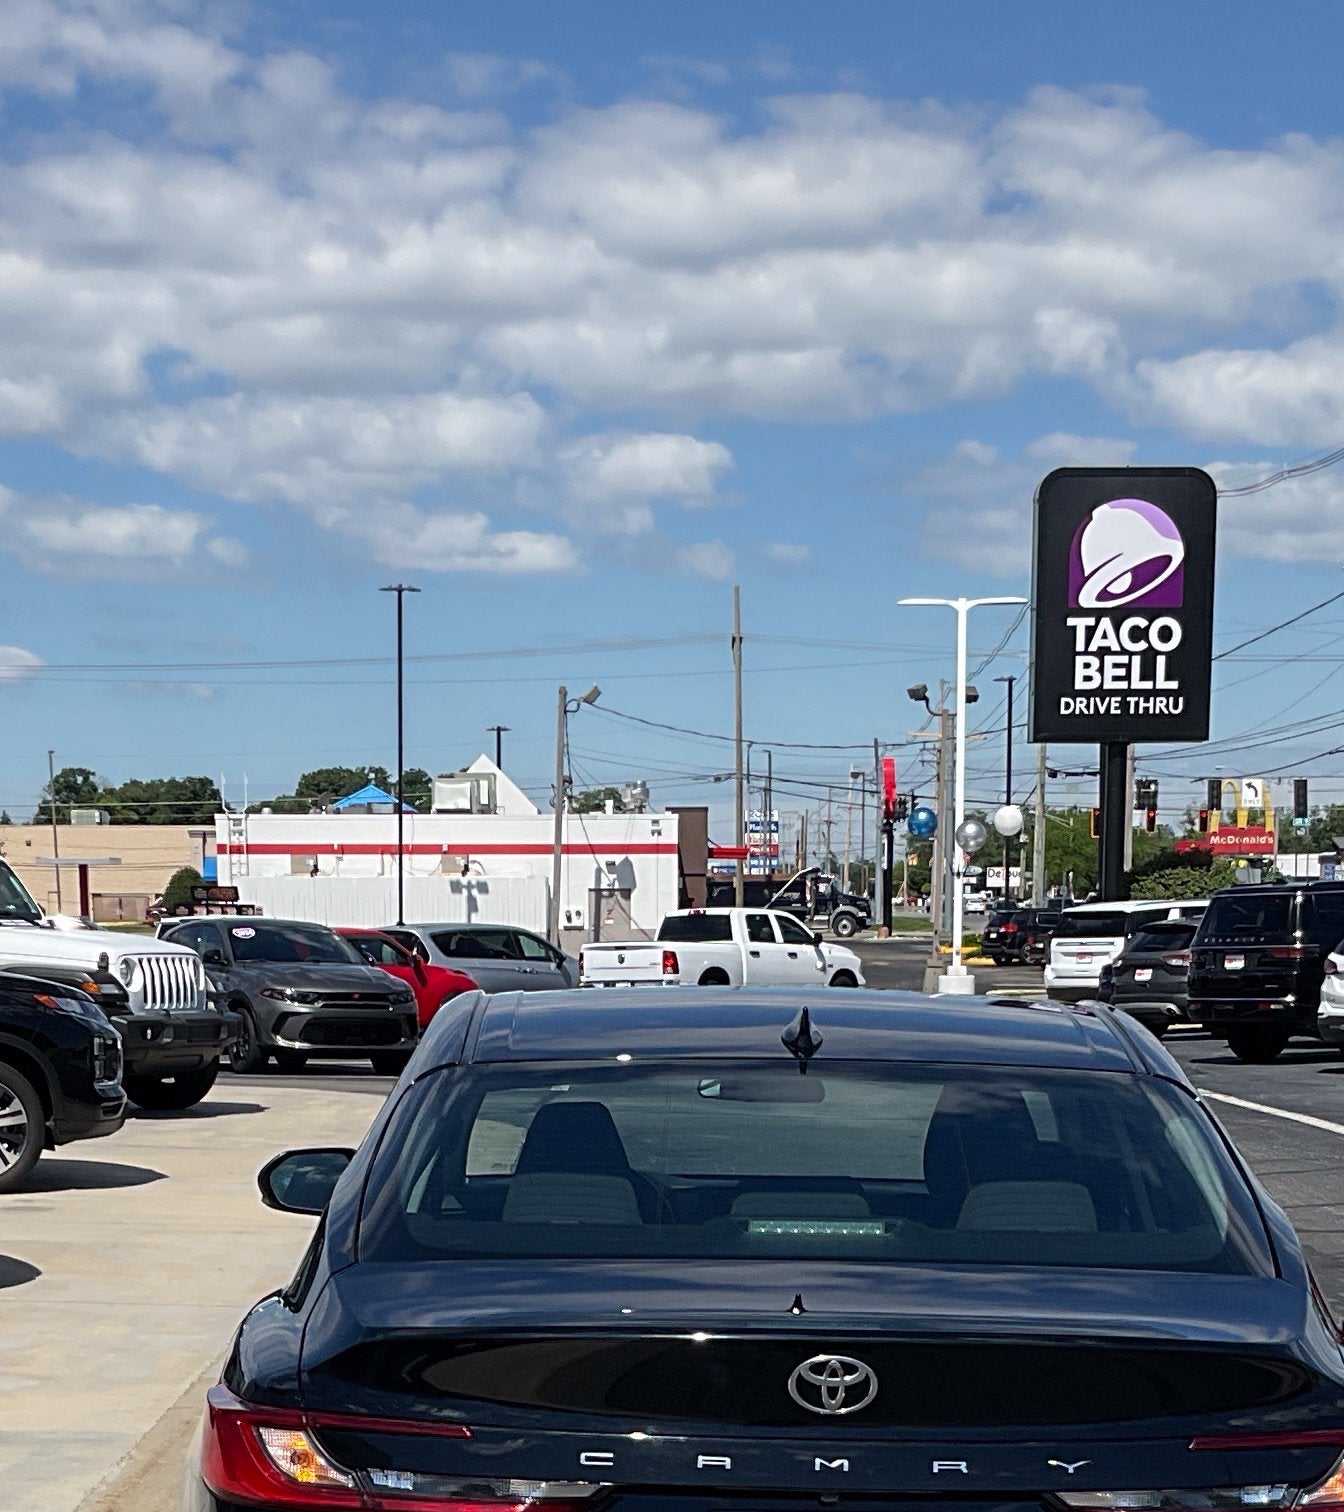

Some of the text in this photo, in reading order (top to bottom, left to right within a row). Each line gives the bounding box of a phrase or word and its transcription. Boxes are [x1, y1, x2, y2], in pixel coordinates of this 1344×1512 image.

[1066, 616, 1183, 653] TACO
[1073, 654, 1180, 690] BELL
[1059, 696, 1184, 715] DRIVE THRU
[1209, 834, 1274, 845] McDonald's
[579, 1450, 1093, 1474] CAMRY
